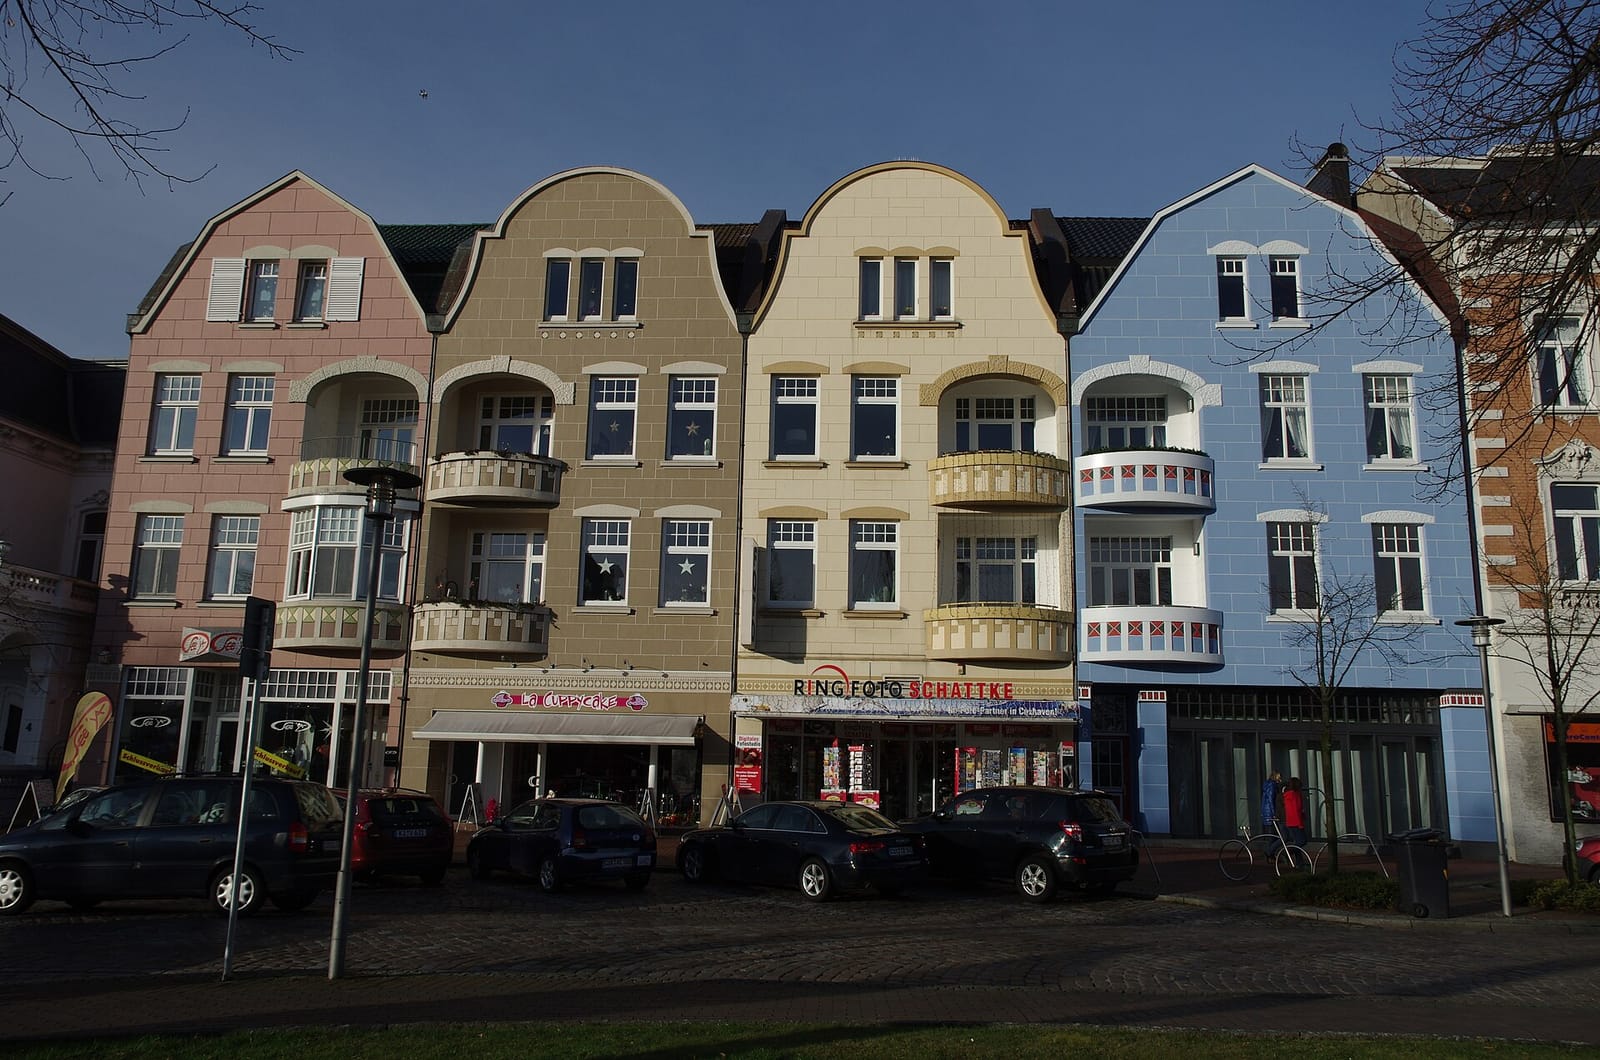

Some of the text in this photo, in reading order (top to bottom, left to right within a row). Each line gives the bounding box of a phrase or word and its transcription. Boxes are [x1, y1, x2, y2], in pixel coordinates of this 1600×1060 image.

[852, 680, 902, 698] FOTO
[909, 681, 1014, 700] SCHATTKE
[1009, 707, 1016, 715] in
[122, 752, 173, 775] Schlussverkauf
